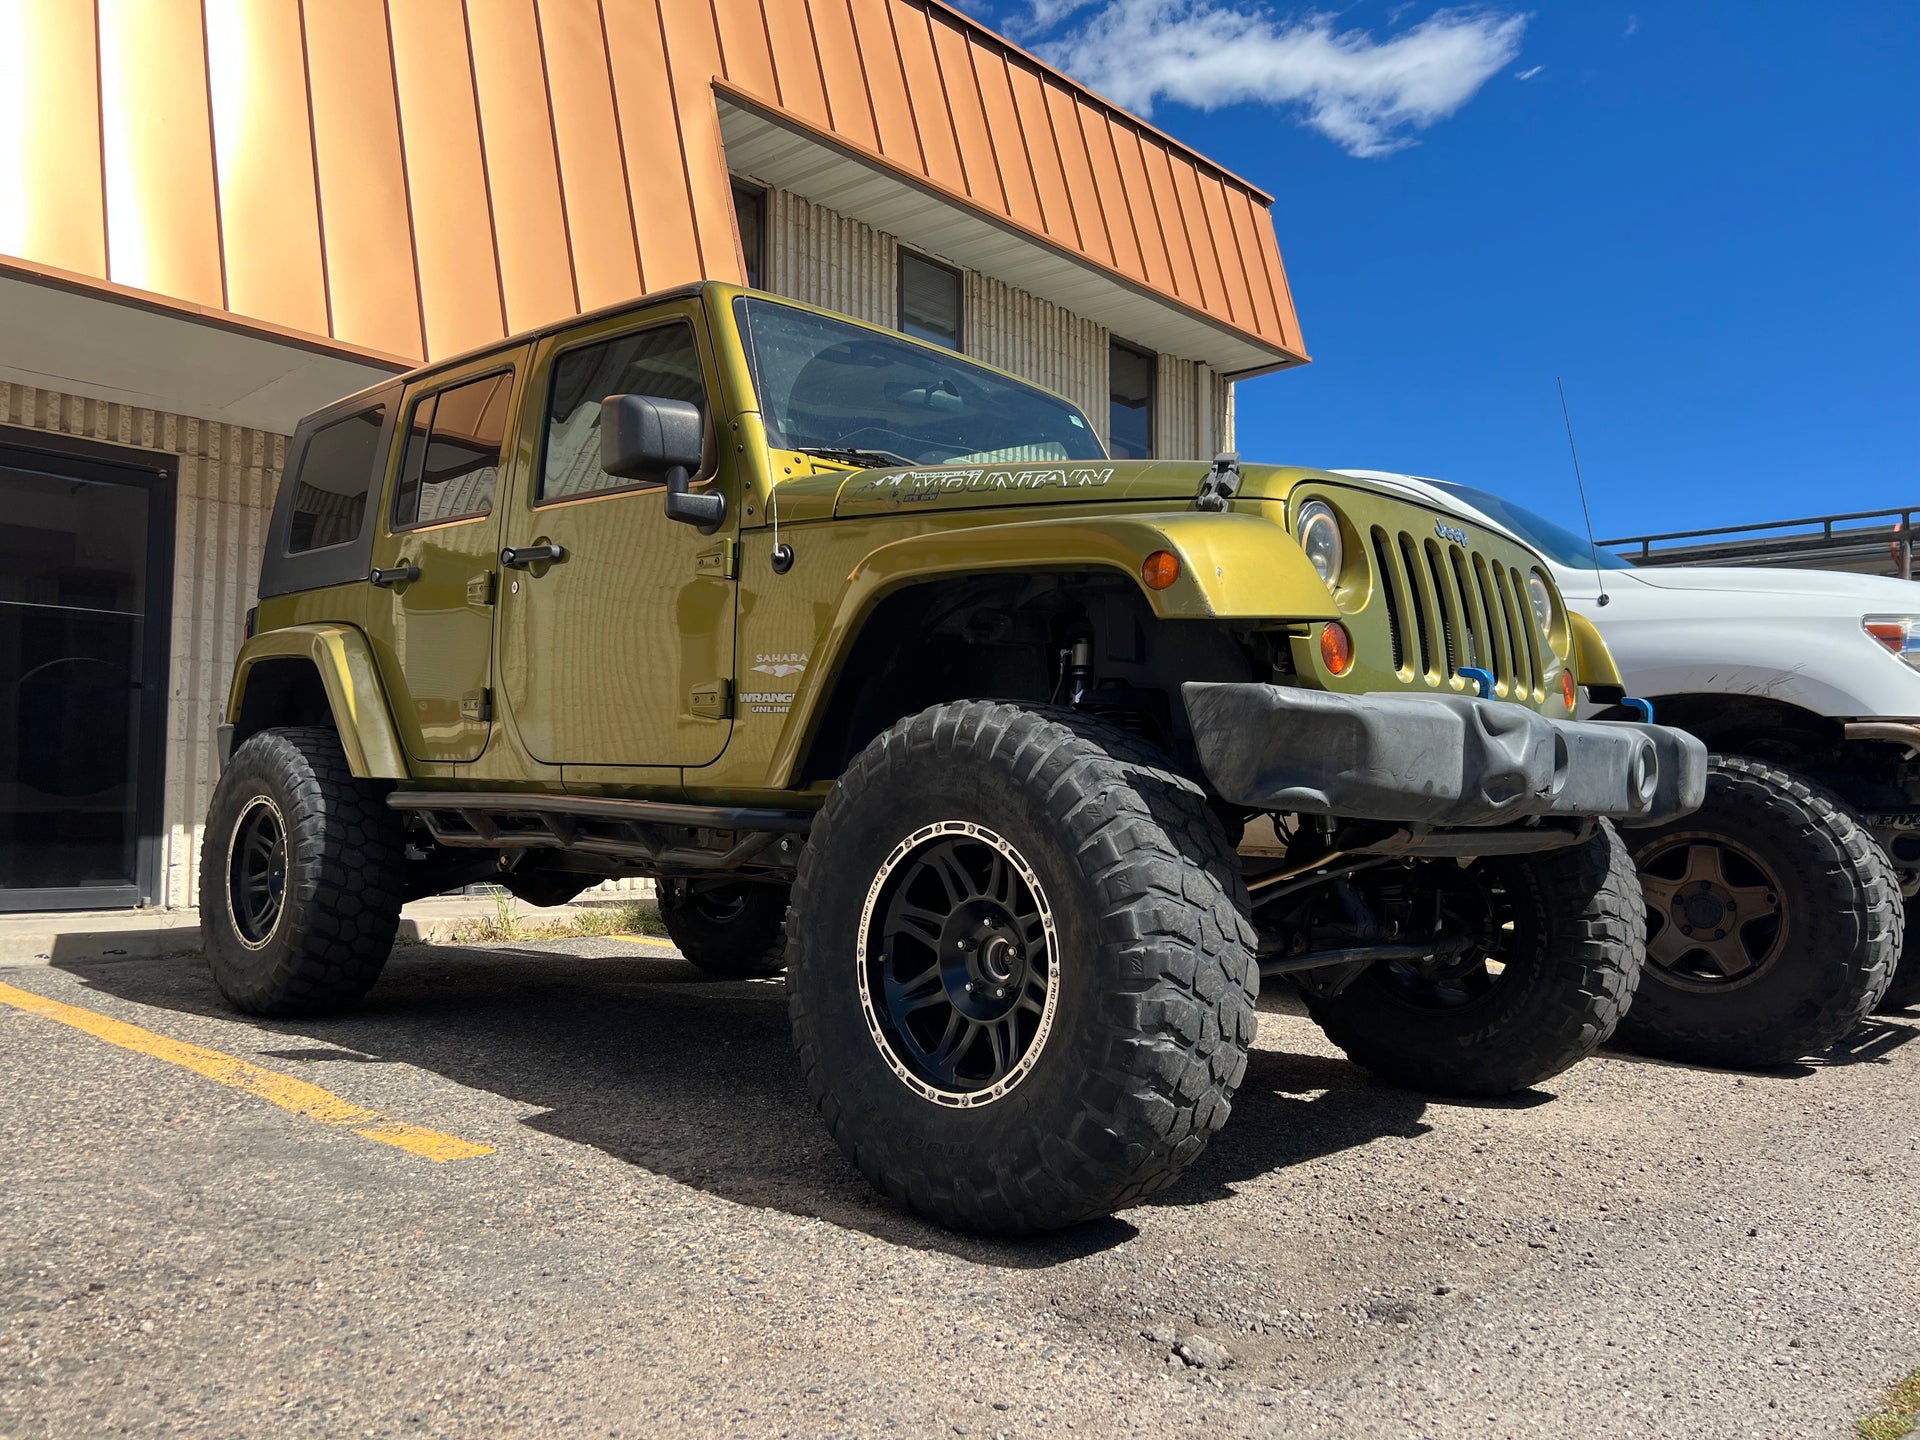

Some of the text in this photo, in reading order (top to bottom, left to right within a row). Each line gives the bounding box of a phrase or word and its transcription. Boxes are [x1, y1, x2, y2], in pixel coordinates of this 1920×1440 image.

[911, 468, 1114, 495] MOUNTAIN
[1435, 517, 1468, 548] Jeep
[755, 653, 808, 663] SAHARA
[861, 905, 869, 928] COMP
[867, 876, 882, 904] XTREME
[1046, 1001, 1055, 1027] COMP
[1031, 1029, 1048, 1058] XTREME
